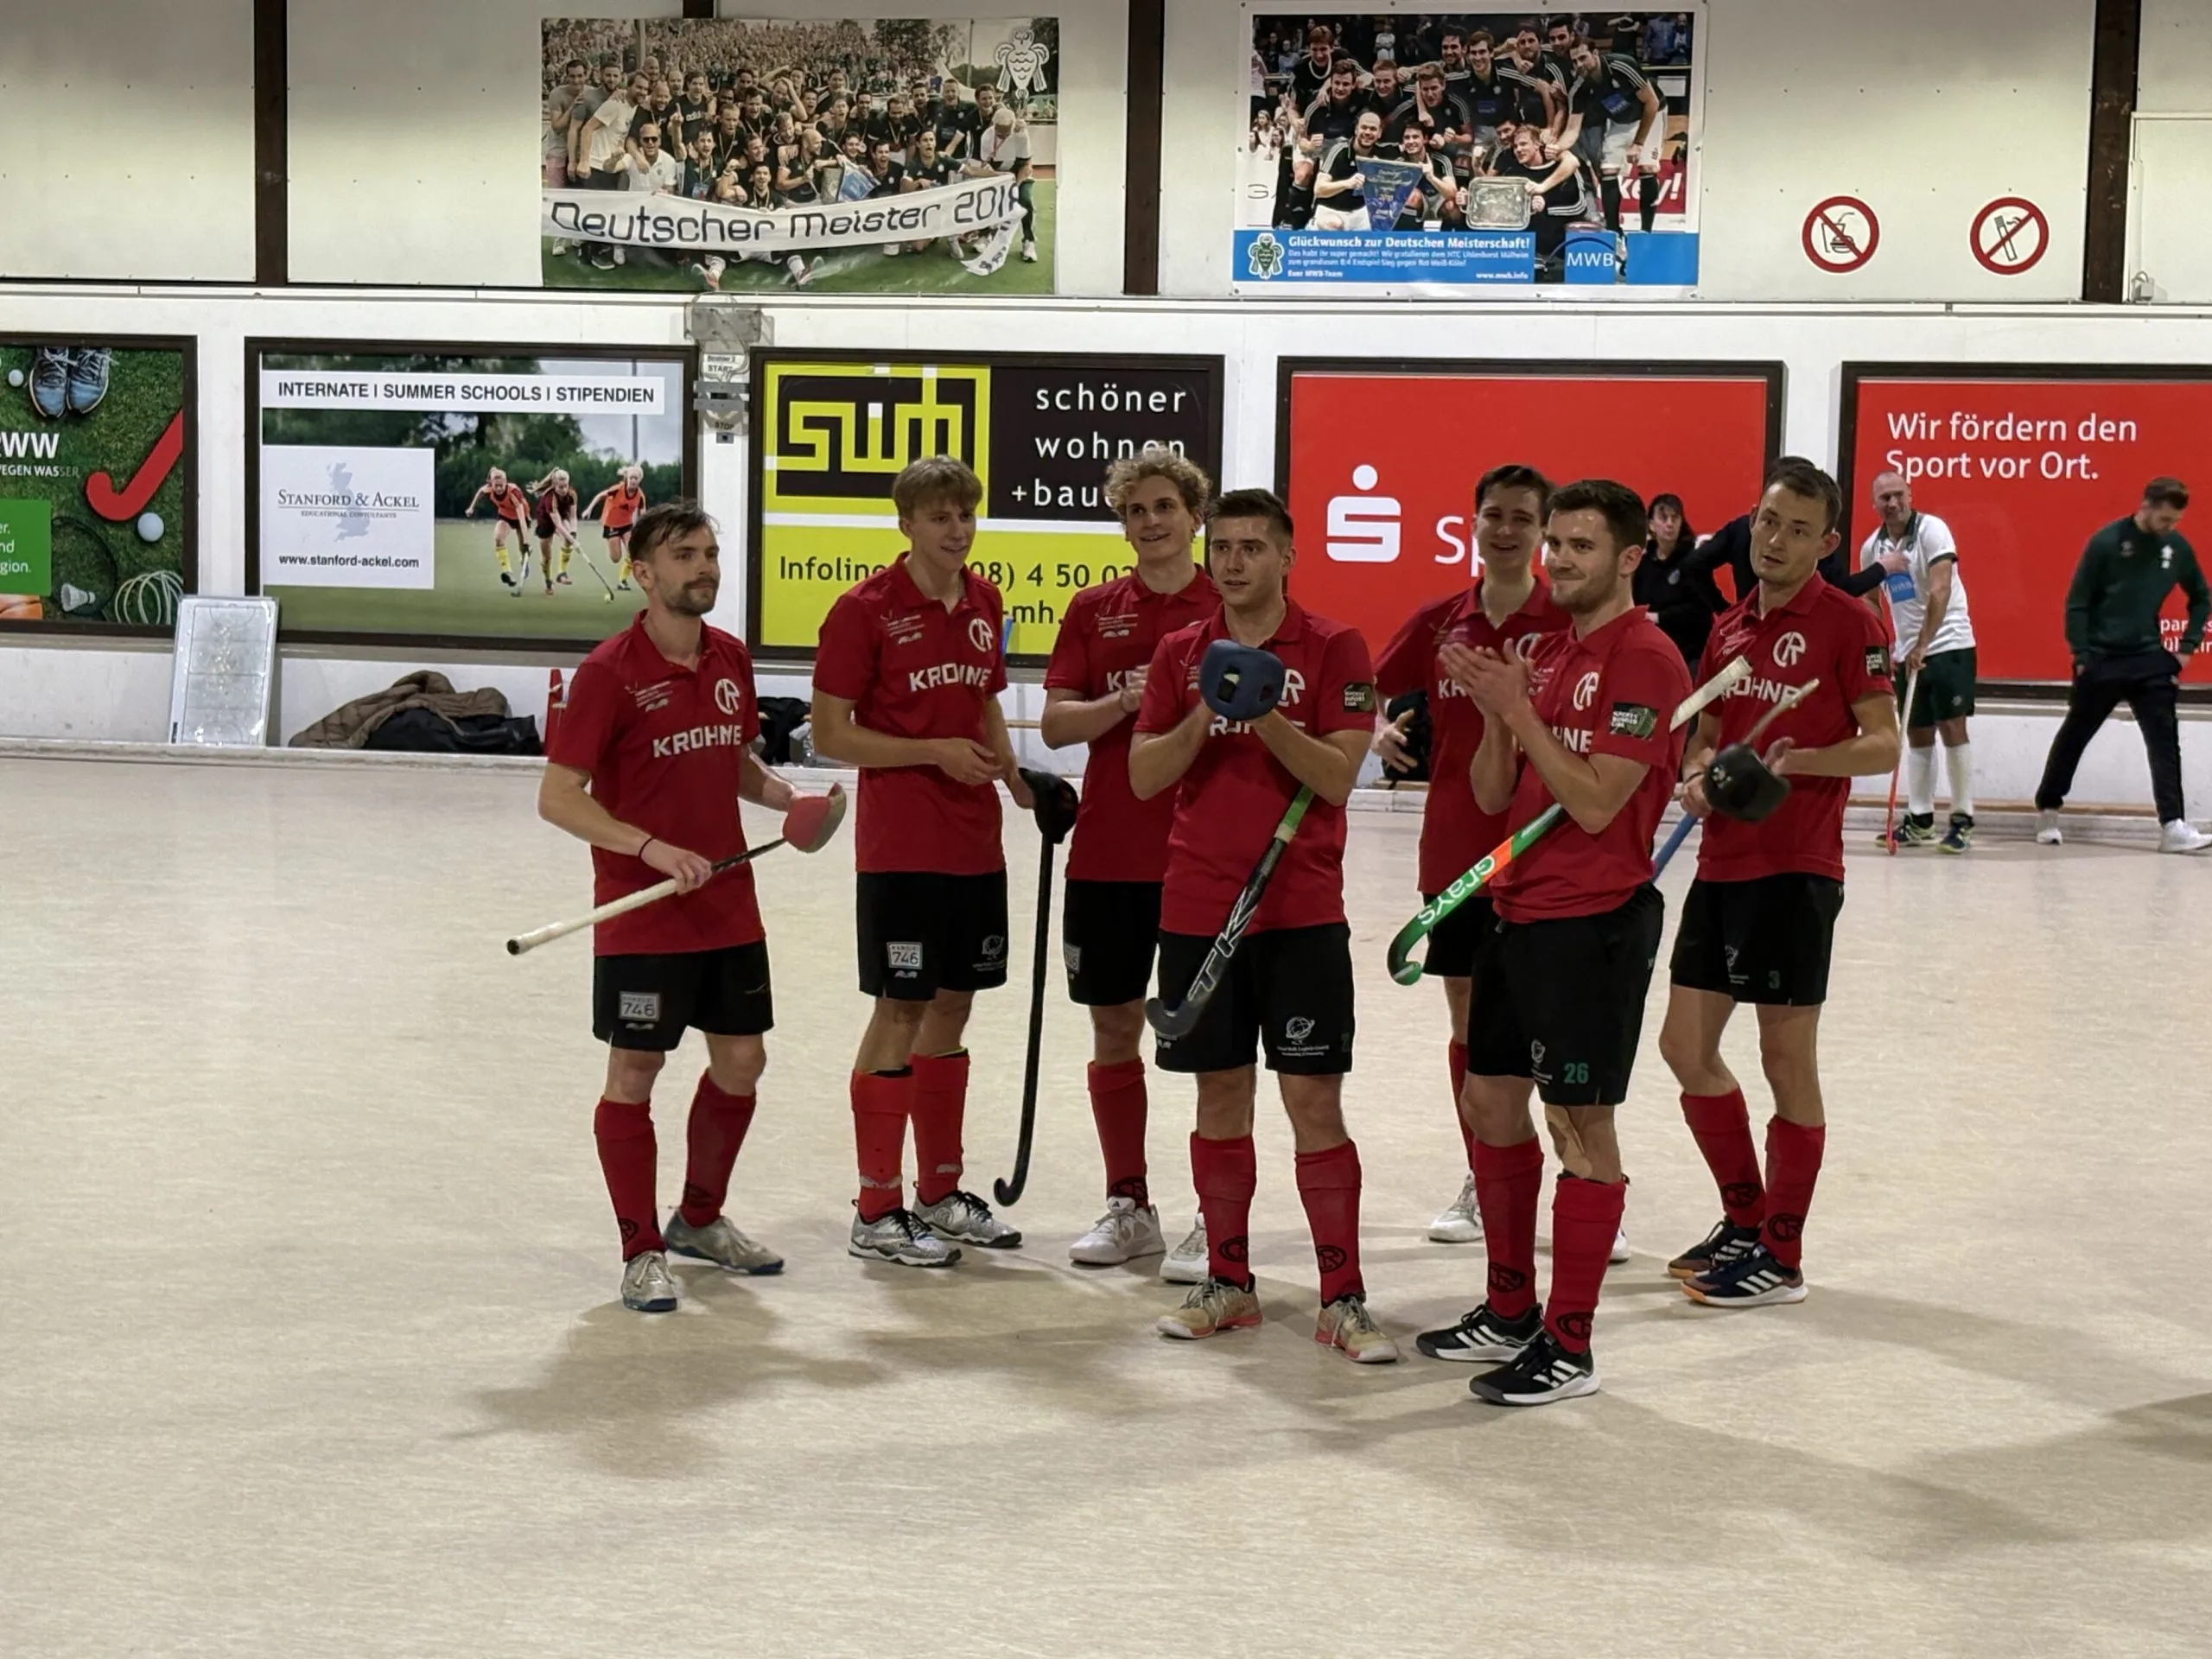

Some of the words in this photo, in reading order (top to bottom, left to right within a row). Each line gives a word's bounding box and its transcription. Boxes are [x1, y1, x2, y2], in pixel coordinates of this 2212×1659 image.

[551, 200, 774, 243] Deutscher
[1288, 236, 1362, 247] Glückwunsch
[1364, 239, 1382, 248] zur
[1385, 237, 1445, 248] Deutschen
[1447, 237, 1529, 249] Meisterschaft!
[1567, 251, 1614, 267] MWB
[277, 381, 370, 398] INTERNATE
[384, 383, 456, 401] SUMMER
[461, 385, 543, 403] SCHOOLS
[556, 385, 655, 404] STIPENDIEN
[1036, 383, 1187, 413] schöner
[1887, 412, 1942, 440] Wir
[1949, 412, 2068, 442] fördern
[2077, 414, 2138, 442] den
[0, 431, 60, 460] WW
[1035, 431, 1185, 460] wohnen
[0, 464, 32, 476] EGEN
[34, 465, 79, 478] WASSER
[1885, 449, 1971, 484] Sport
[1980, 457, 2031, 479] vor
[2039, 451, 2100, 480] Ort.
[277, 488, 352, 506] STANFORD
[355, 492, 370, 507] &
[372, 491, 420, 508] ACKEL
[1011, 478, 1113, 508] +bau
[301, 510, 346, 518] EDUCATIONAL
[349, 511, 397, 519] CONSULTANTS
[278, 553, 420, 569] www.stanford-ackel.com
[1027, 563, 1044, 588] 4
[1056, 563, 1090, 588] 50
[652, 724, 742, 759] KROHNE
[892, 950, 919, 965] 746
[622, 1001, 656, 1018] 746
[1563, 1062, 1590, 1085] 26
